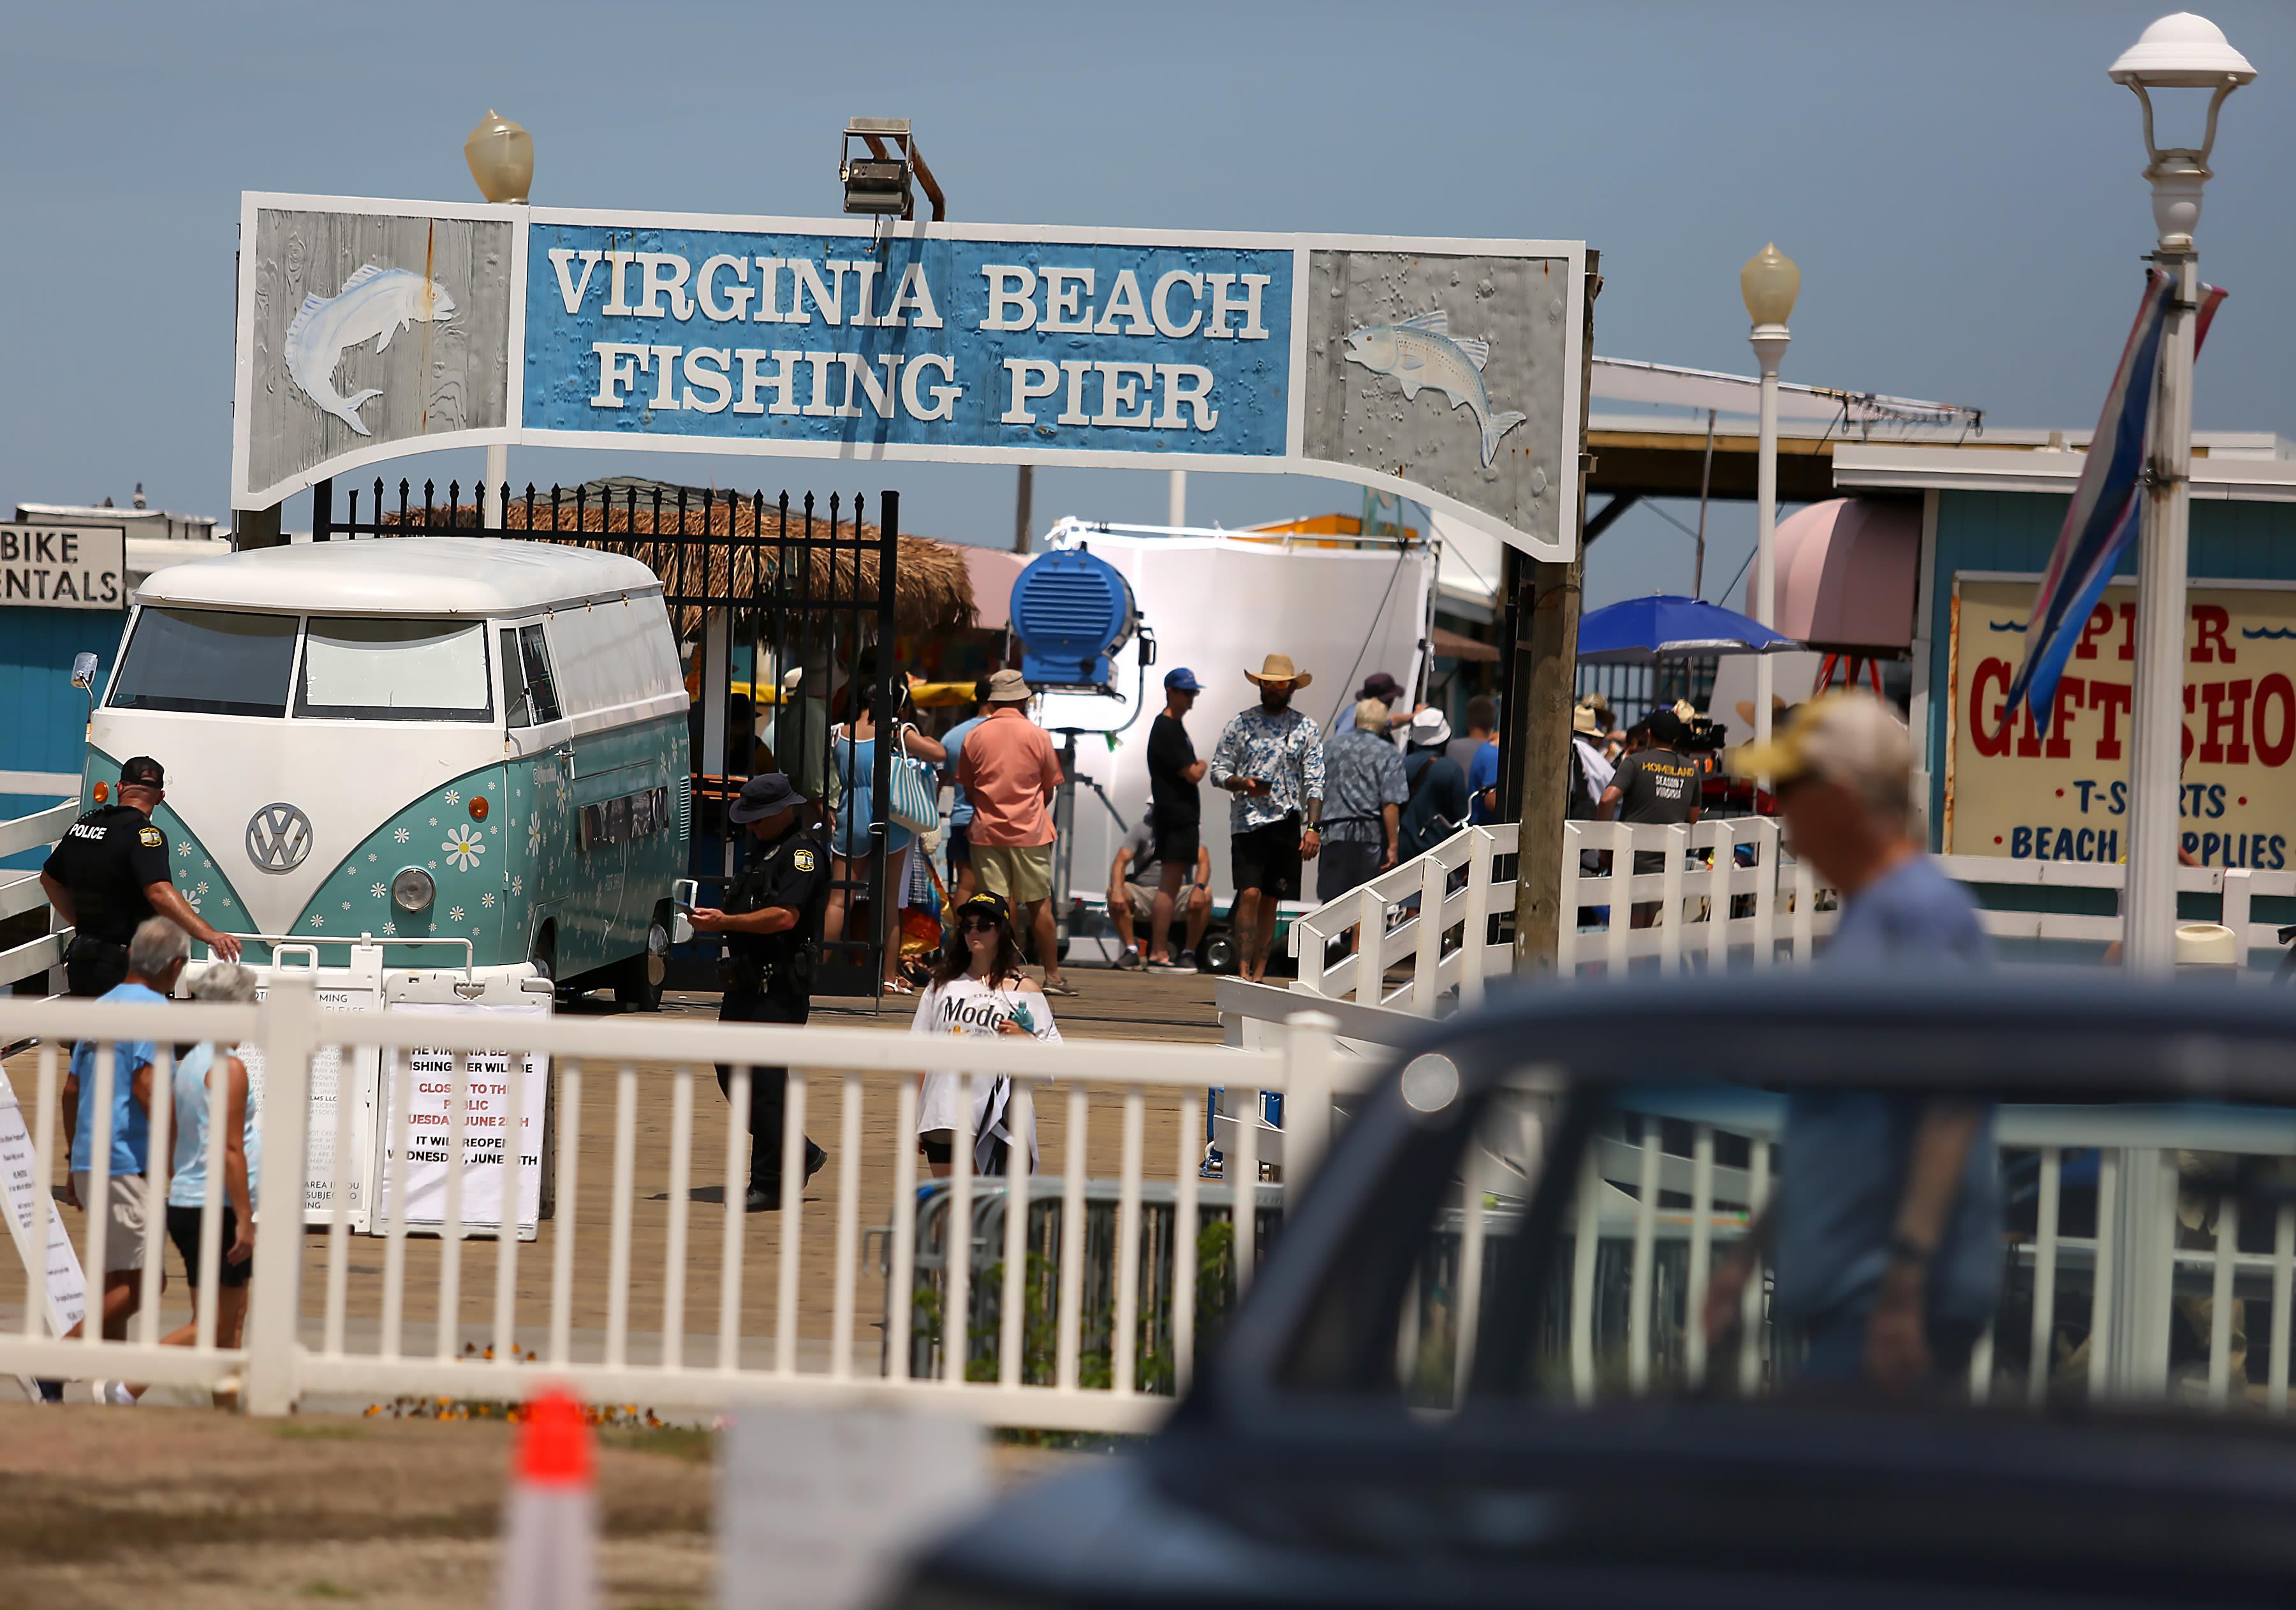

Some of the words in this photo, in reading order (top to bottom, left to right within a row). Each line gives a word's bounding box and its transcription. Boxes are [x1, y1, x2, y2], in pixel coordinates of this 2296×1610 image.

[548, 249, 943, 328] VIRGINIA
[980, 265, 1270, 339] BEACH
[591, 342, 962, 422] FISHING
[1001, 358, 1218, 432] PIER
[1, 531, 78, 564] BIKE
[0, 568, 117, 602] NTALS
[2076, 602, 2236, 663] PIR
[2073, 781, 2226, 818] T-SRTS
[69, 823, 107, 839] POLICE
[2011, 827, 2118, 862] BEACH
[2180, 831, 2286, 870] PPLIES
[943, 996, 1015, 1031] Mode
[409, 1061, 453, 1072] ISHING
[412, 1047, 429, 1055] HE
[470, 1084, 487, 1094] TO
[464, 1116, 496, 1127] JUNE
[416, 1136, 427, 1145] IT
[471, 1153, 504, 1164] JUNE
